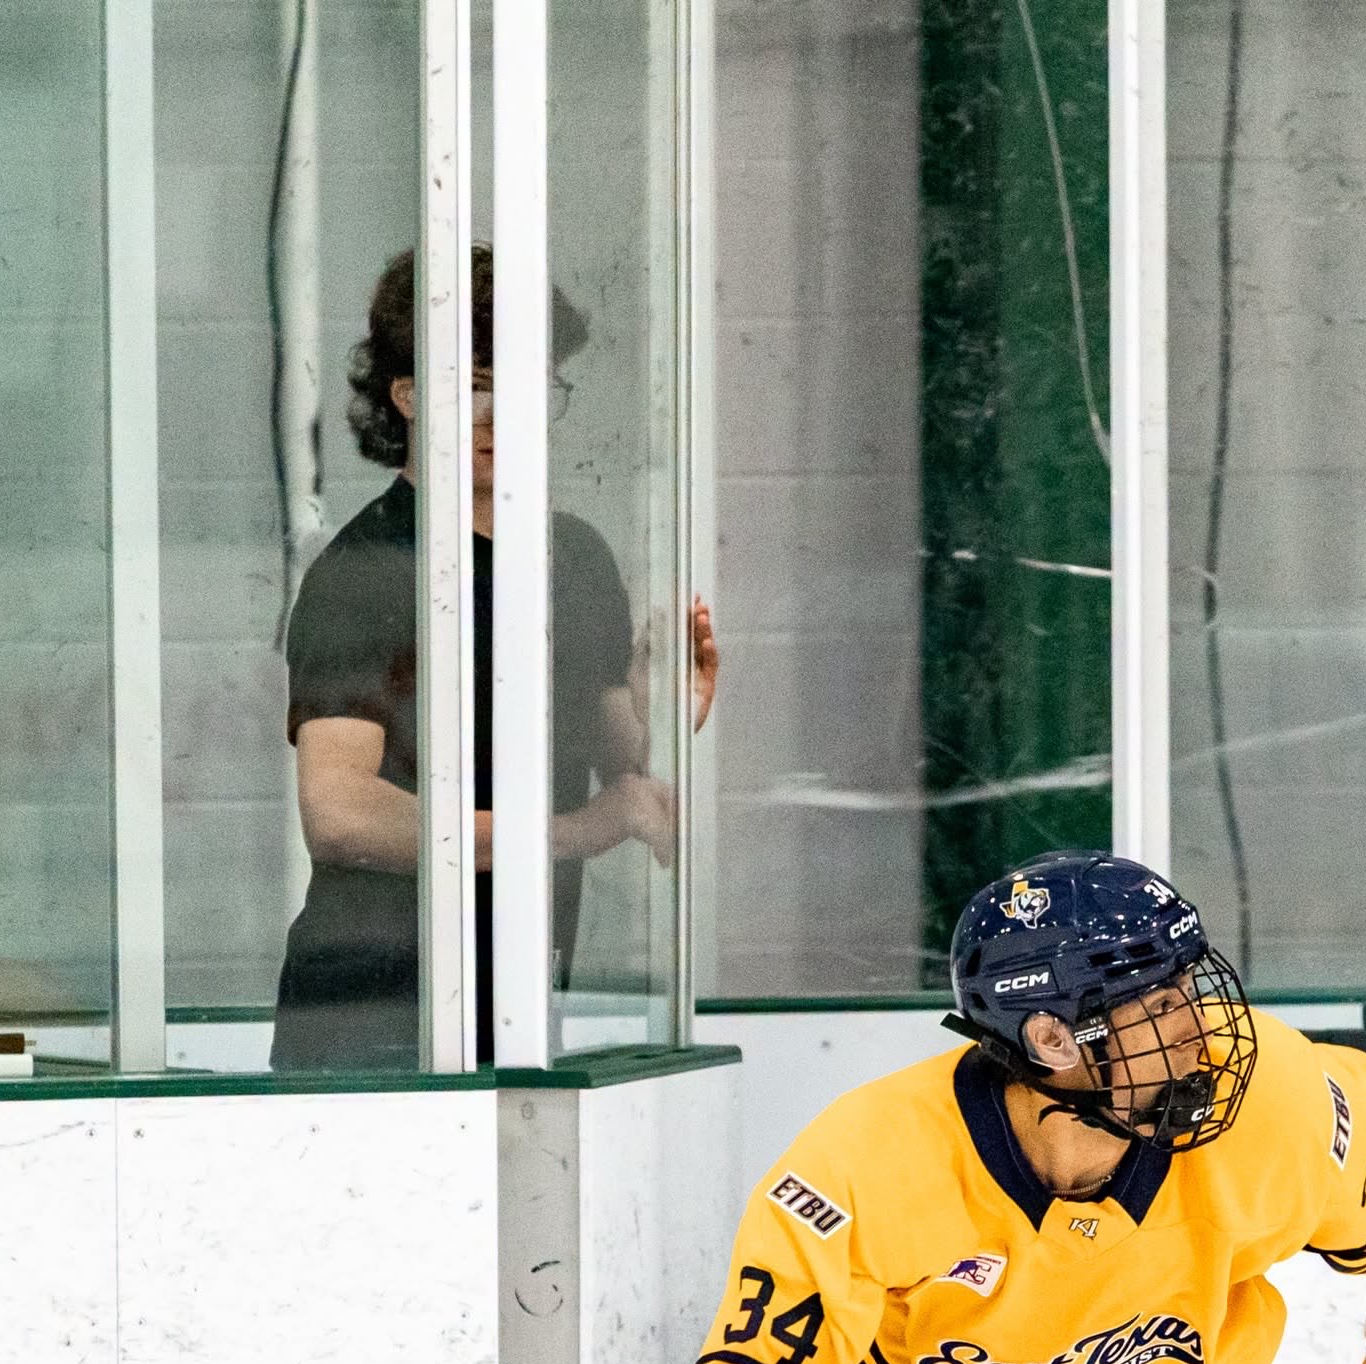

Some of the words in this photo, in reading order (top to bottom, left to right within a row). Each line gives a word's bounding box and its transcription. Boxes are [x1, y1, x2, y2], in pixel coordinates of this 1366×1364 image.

[1169, 911, 1198, 940] CCM
[995, 971, 1050, 993] CCM
[1075, 1028, 1109, 1045] CCM
[1191, 1105, 1215, 1122] CC
[1325, 1076, 1350, 1164] ETBU
[770, 1174, 847, 1235] ETBU
